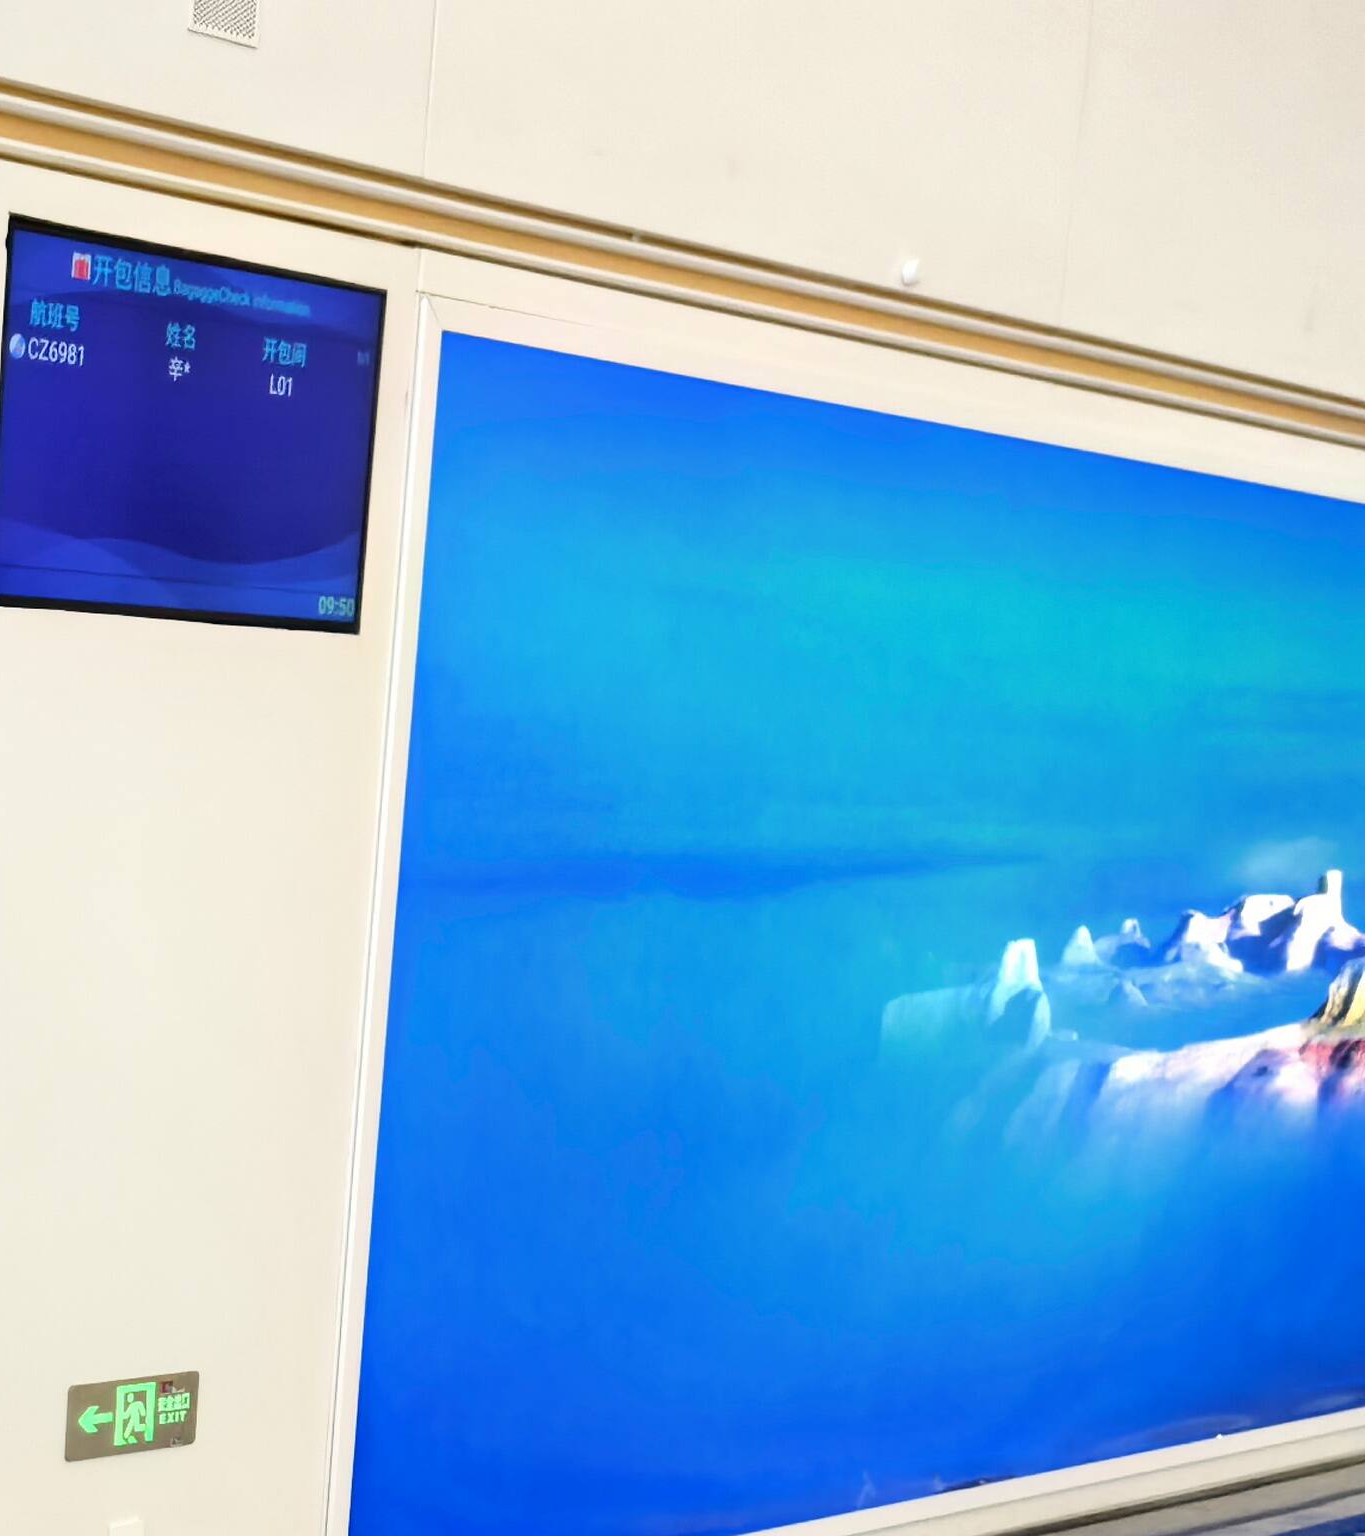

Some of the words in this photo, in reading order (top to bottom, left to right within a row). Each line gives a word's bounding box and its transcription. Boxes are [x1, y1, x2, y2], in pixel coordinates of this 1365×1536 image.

[92, 255, 171, 297] 开包信息
[29, 298, 80, 332] 航班号
[165, 322, 196, 350] 姓名
[28, 337, 85, 367] CZ6981
[262, 337, 307, 368] 开包间
[269, 373, 294, 397] L01
[158, 1392, 190, 1412] 安全出口
[159, 1411, 187, 1424] EXIT
